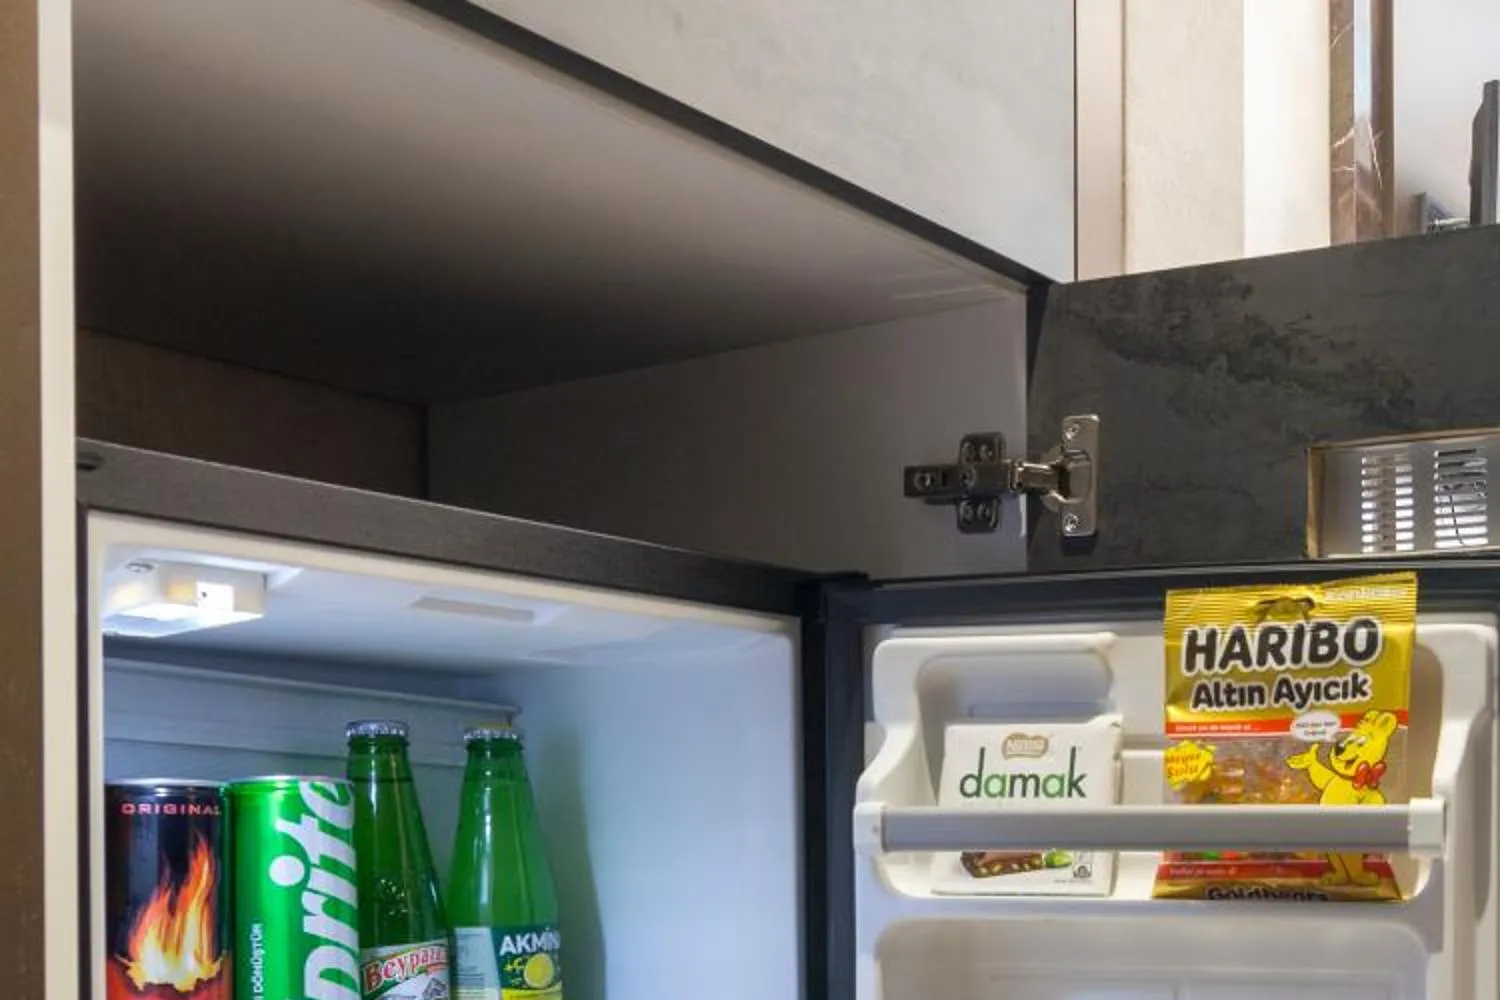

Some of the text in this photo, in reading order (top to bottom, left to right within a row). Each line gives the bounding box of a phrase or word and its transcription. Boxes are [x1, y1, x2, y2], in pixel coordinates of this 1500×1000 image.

[1183, 617, 1380, 675] HARIBO
[1191, 671, 1370, 710] Altın Ayıcık
[959, 745, 1088, 799] damak
[120, 802, 222, 816] ORIGINAL
[500, 927, 562, 955] AKMİN
